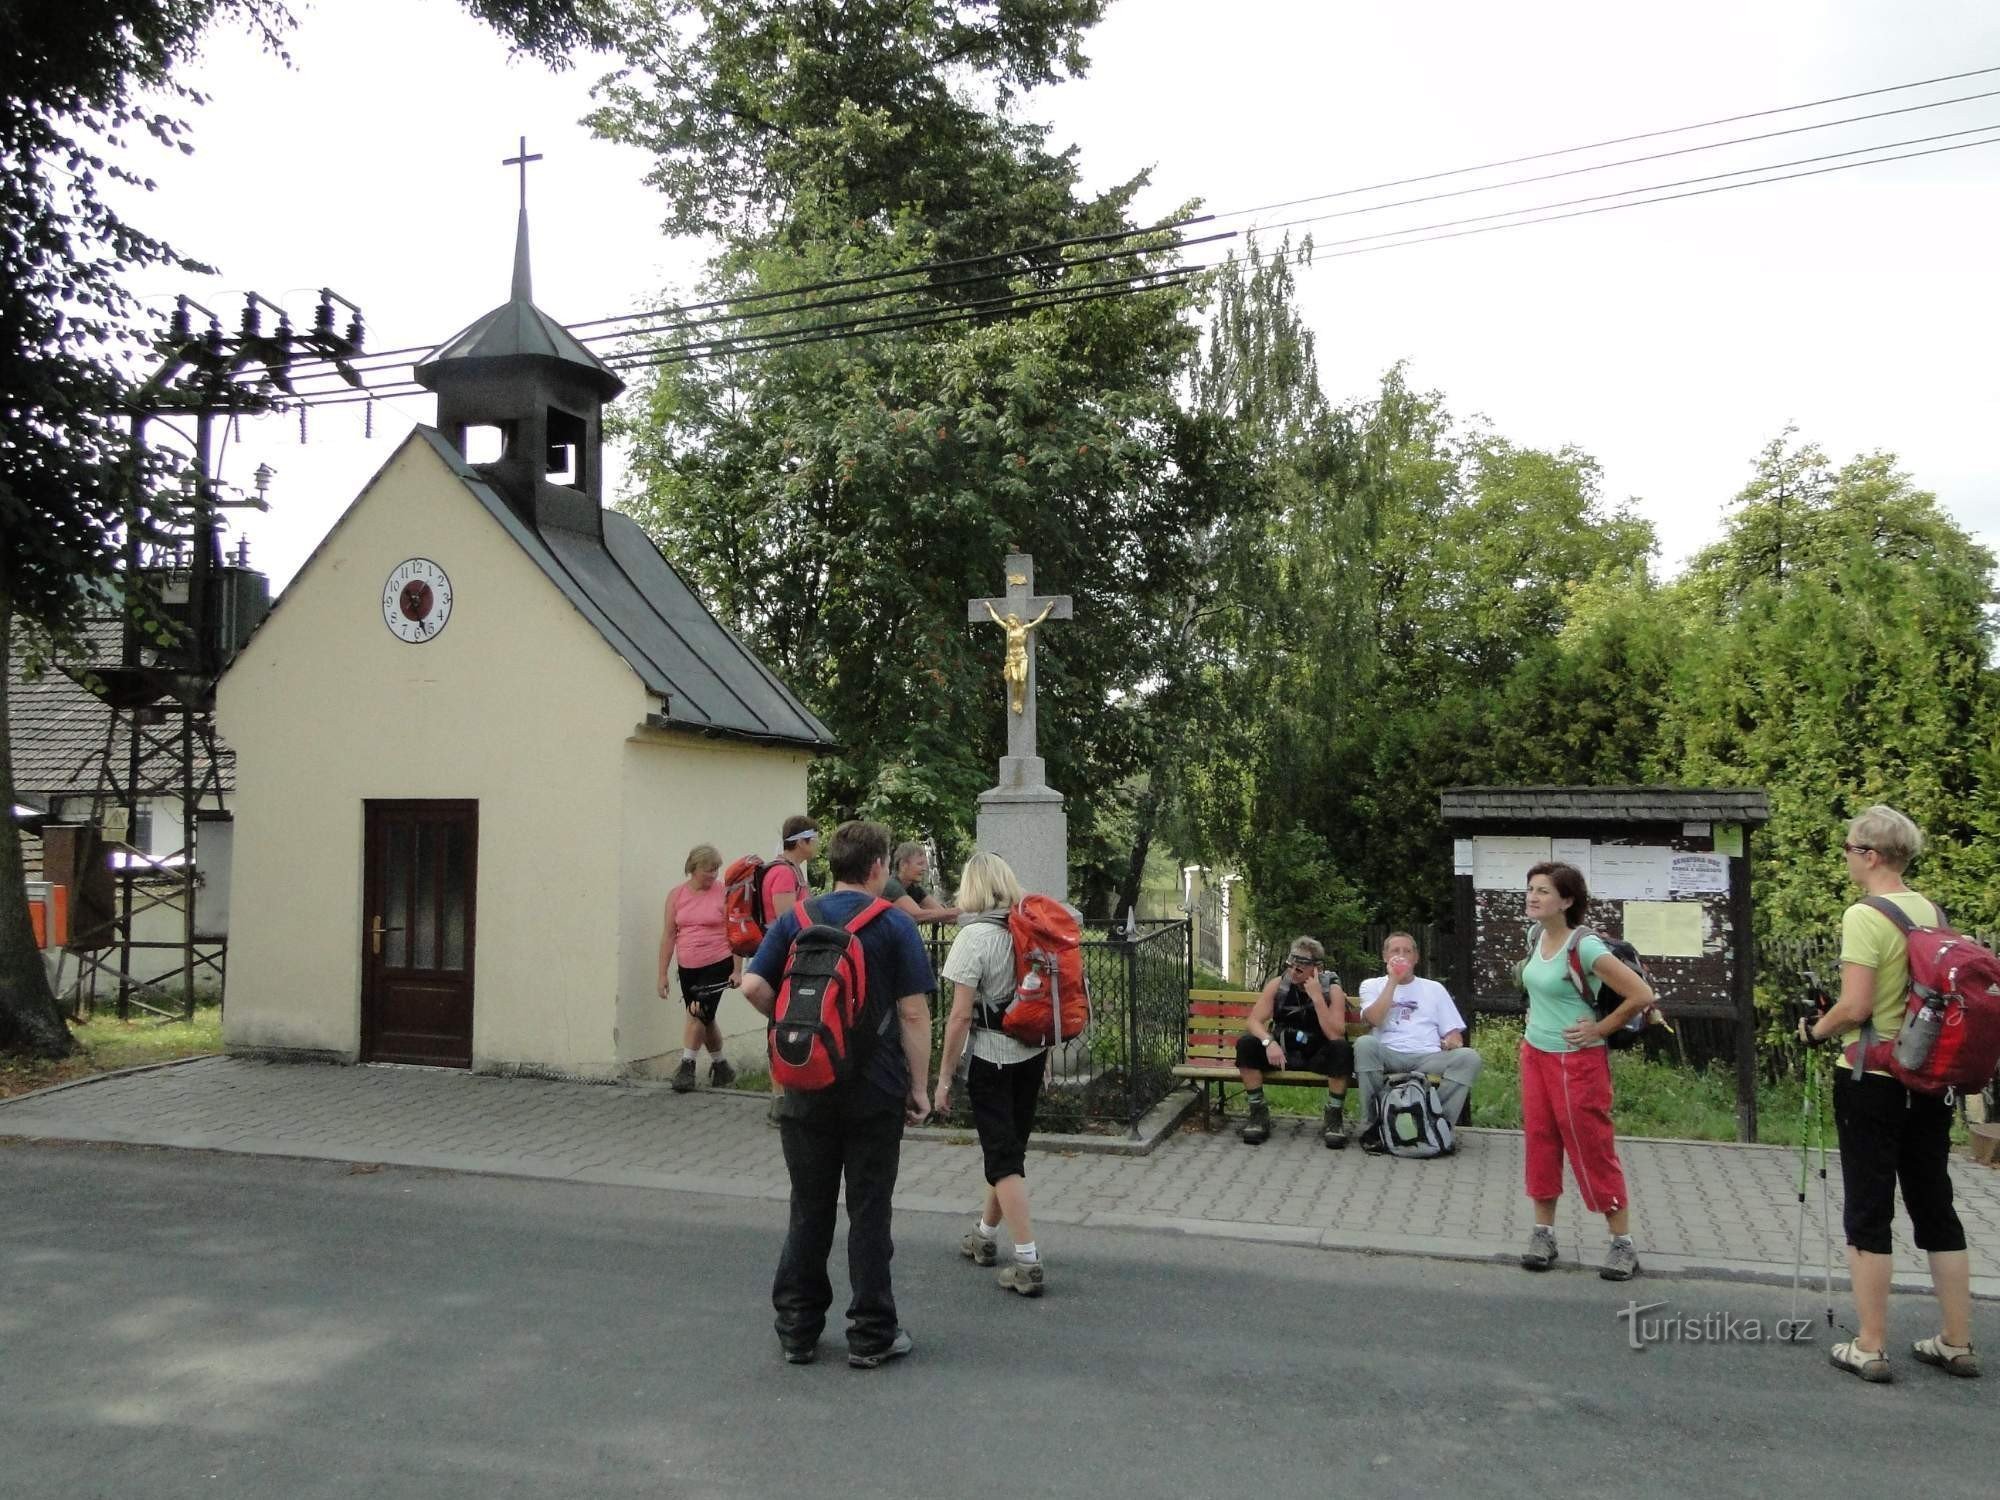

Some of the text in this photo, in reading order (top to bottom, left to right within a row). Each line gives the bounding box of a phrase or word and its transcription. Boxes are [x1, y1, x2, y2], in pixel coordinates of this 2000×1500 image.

[401, 567, 409, 579] 11
[412, 561, 423, 574] 12
[428, 565, 432, 577] 1
[390, 580, 400, 592] 10
[437, 575, 445, 587] 2
[386, 595, 393, 608] 9
[442, 592, 449, 605] 3
[390, 611, 398, 624] 8
[437, 609, 444, 621] 4
[401, 623, 408, 636] 7
[414, 627, 421, 640] 6
[427, 622, 435, 635] 5
